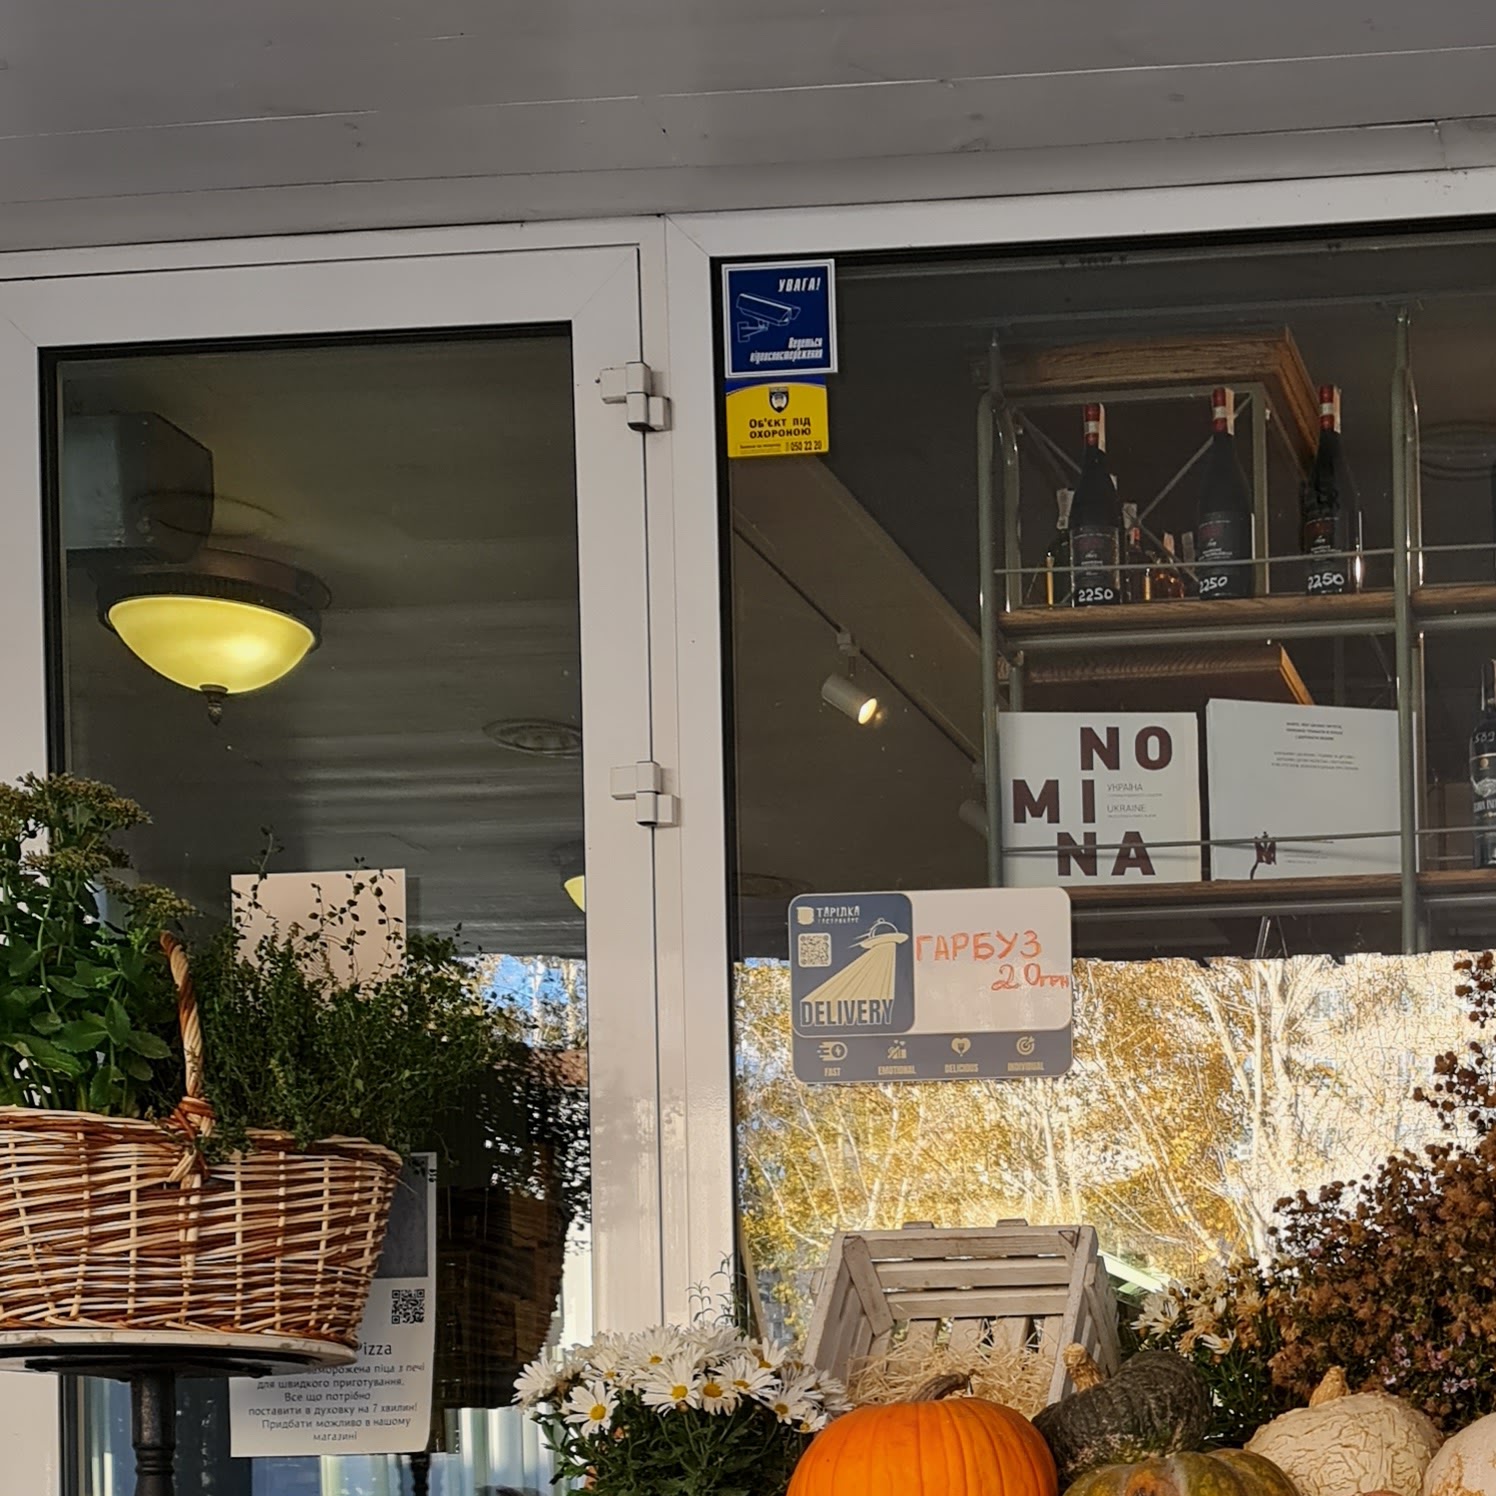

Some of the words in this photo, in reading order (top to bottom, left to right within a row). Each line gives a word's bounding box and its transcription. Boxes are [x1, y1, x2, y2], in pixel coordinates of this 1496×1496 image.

[778, 277, 821, 292] УВАГА!
[749, 428, 811, 439] ОХОРОНОЮ
[1308, 573, 1345, 590] 2250
[1078, 587, 1114, 602] 2250
[1080, 726, 1172, 771] NO
[1012, 779, 1096, 824] MI
[1107, 804, 1146, 813] UKRAINE
[1057, 831, 1156, 877] NA
[816, 905, 860, 918] ТАРІЛКА
[915, 930, 1042, 961] ГАРБУЗ
[800, 999, 895, 1027] DELIVERY
[824, 1067, 841, 1077] FAST
[359, 1342, 392, 1356] izza
[374, 1363, 395, 1374] піца
[257, 1381, 275, 1389] для
[278, 1379, 330, 1389] швидкого
[333, 1378, 405, 1389] приготування.
[284, 1392, 303, 1401] Все
[306, 1393, 323, 1403] що
[326, 1391, 371, 1403] потрібно
[248, 1406, 302, 1416] поставити
[305, 1407, 311, 1415] в
[314, 1406, 355, 1417] духовку
[358, 1406, 369, 1414] на
[373, 1403, 378, 1413] 7
[381, 1402, 418, 1412] хвилин!
[262, 1418, 312, 1431] Придбати
[316, 1419, 362, 1428] можливо
[373, 1418, 412, 1429] нашому
[313, 1431, 357, 1441] магазині
